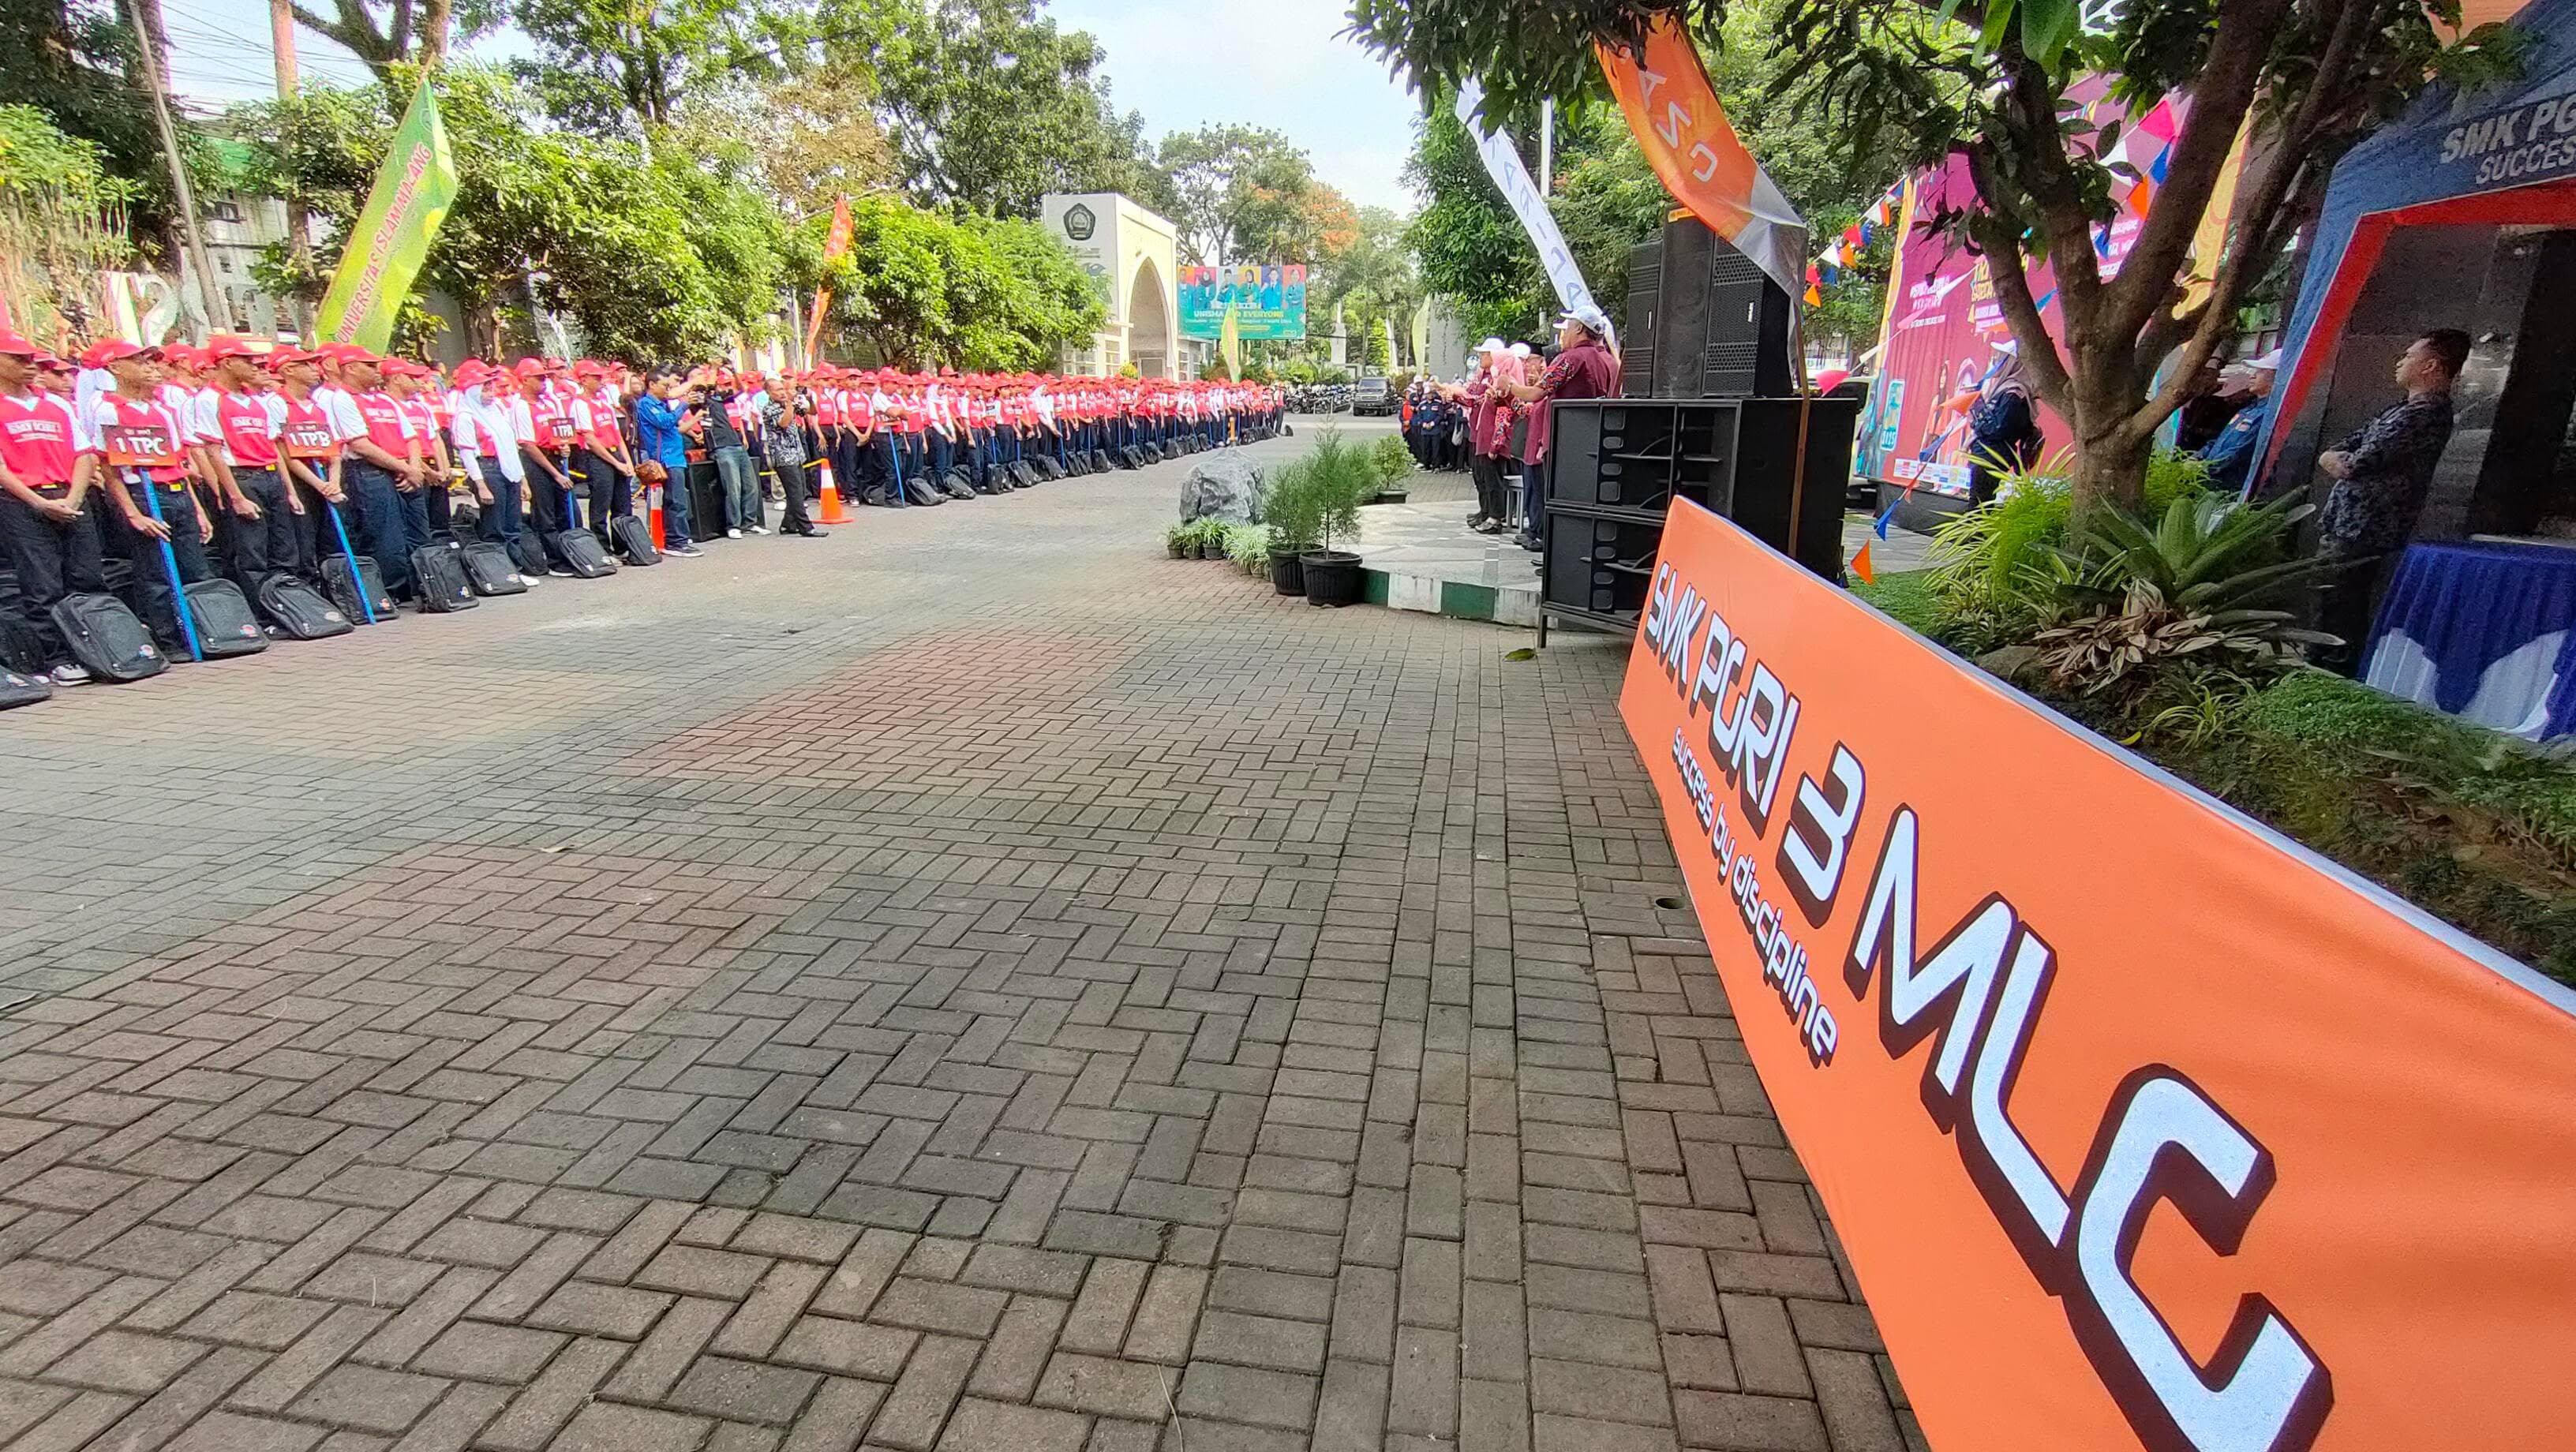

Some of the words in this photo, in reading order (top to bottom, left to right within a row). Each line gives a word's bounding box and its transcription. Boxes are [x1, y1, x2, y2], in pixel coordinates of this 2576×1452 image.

[2439, 109, 2525, 164] SMK
[336, 252, 380, 343] UNIVERSITAS
[375, 205, 402, 254] ISLAM
[396, 142, 432, 208] MALANG
[127, 436, 169, 456] TPC
[298, 430, 331, 447] TPB
[1645, 561, 1706, 699] SMK
[1776, 740, 1865, 929] 3
[1711, 801, 1735, 885] by
[1732, 854, 1837, 1068] discipline
